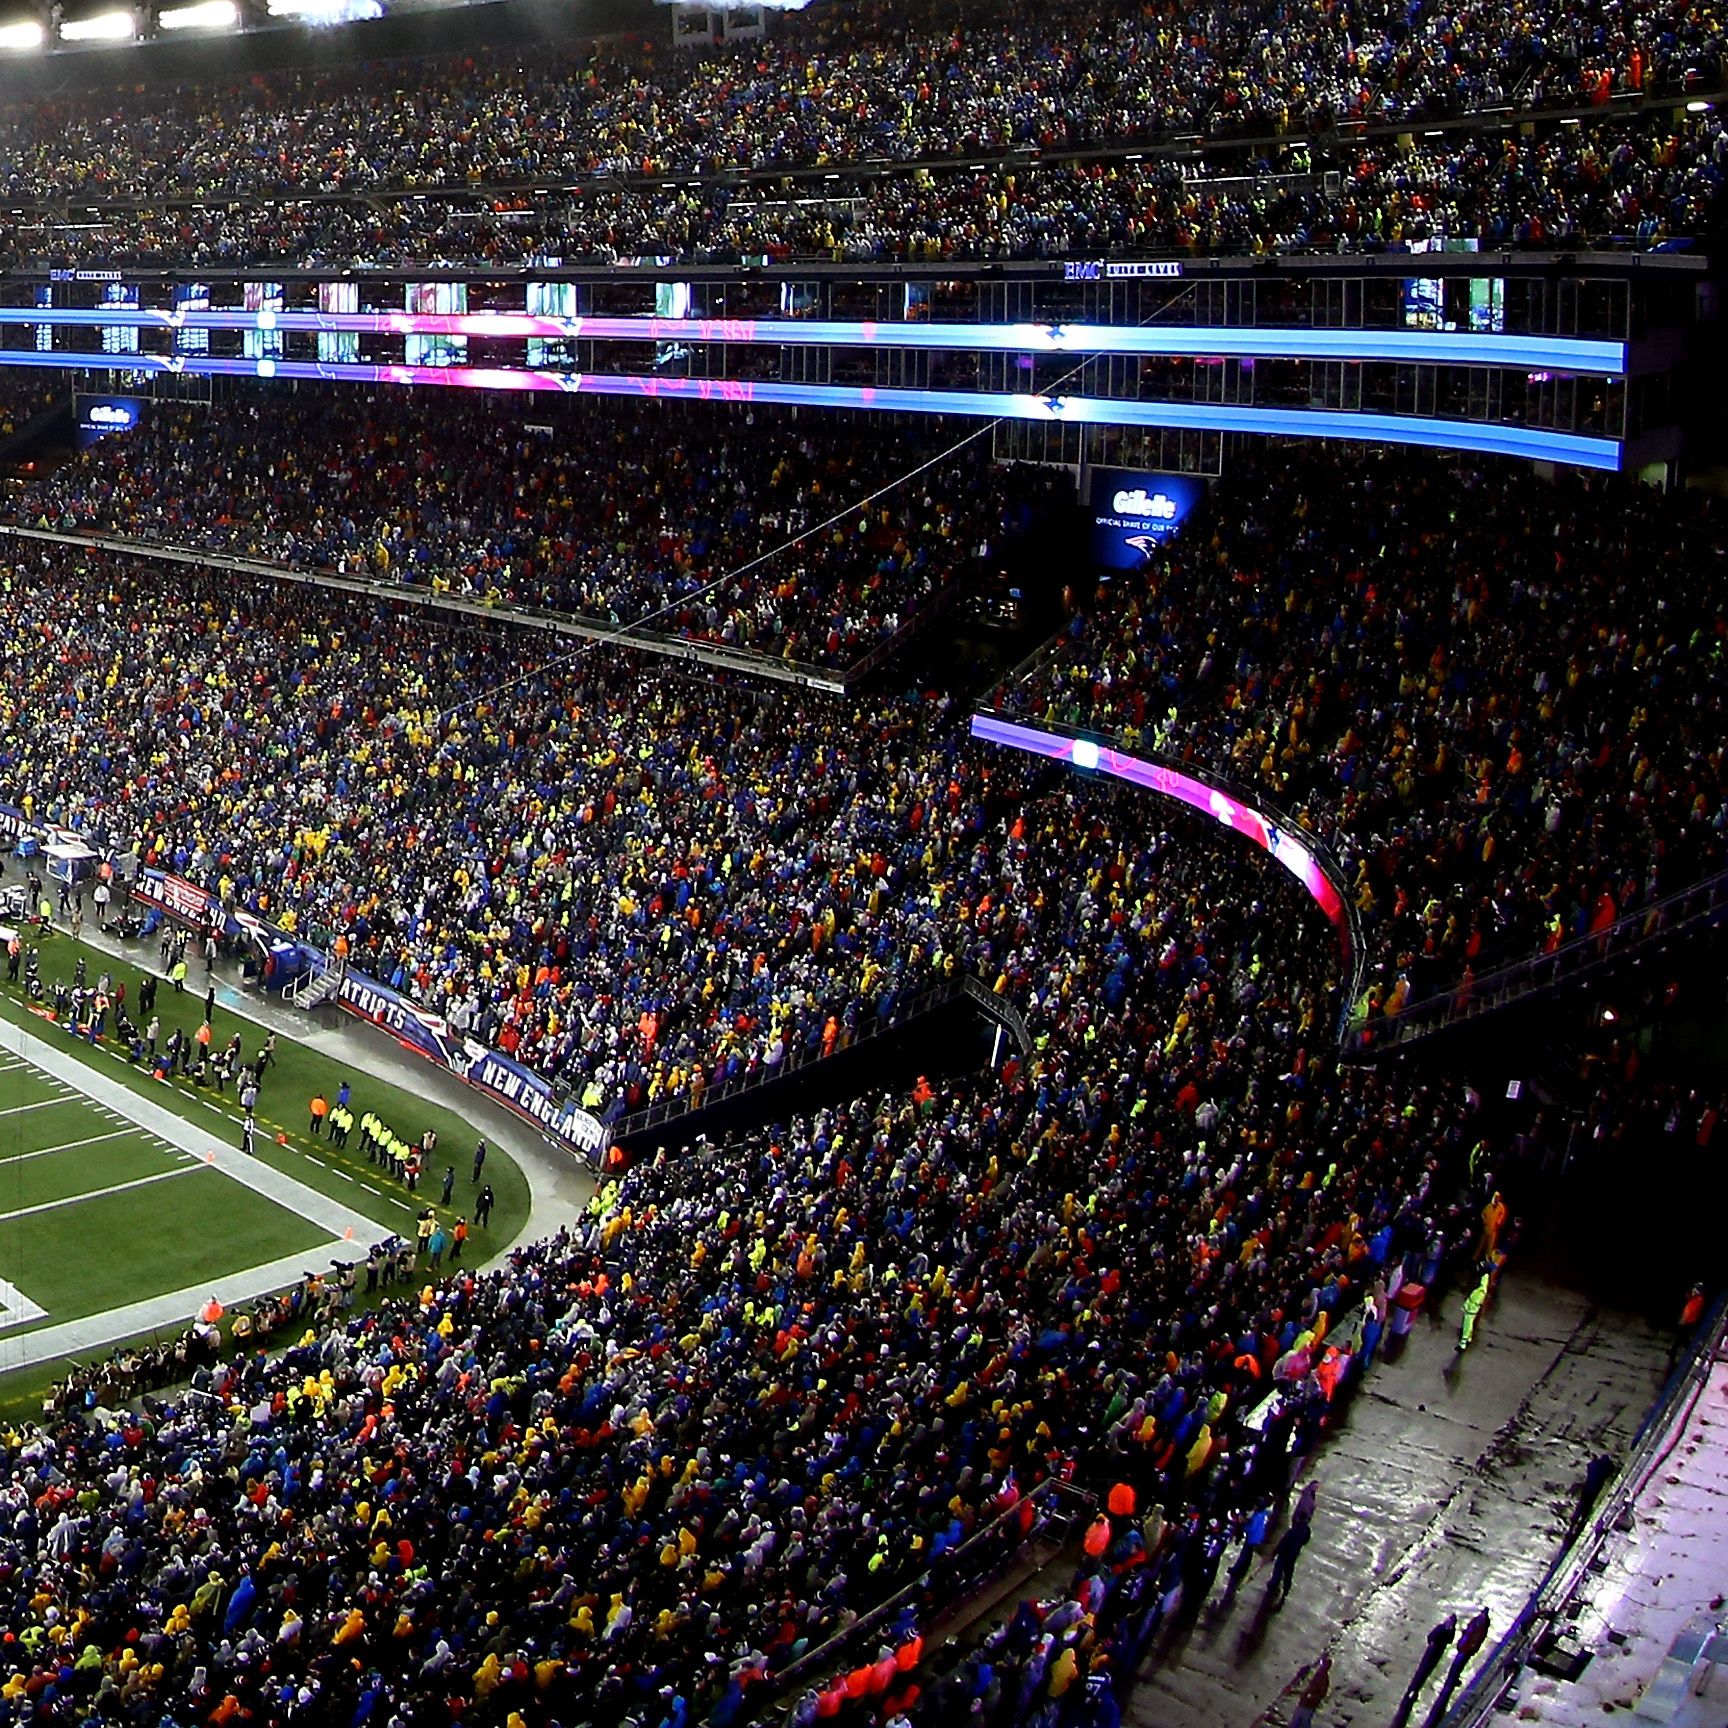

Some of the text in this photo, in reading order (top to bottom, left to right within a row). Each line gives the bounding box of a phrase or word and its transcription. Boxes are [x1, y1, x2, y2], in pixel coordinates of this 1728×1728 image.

[1113, 490, 1176, 519] Gillette
[339, 978, 407, 1030] ATRIOTS
[482, 1060, 521, 1099] NEW
